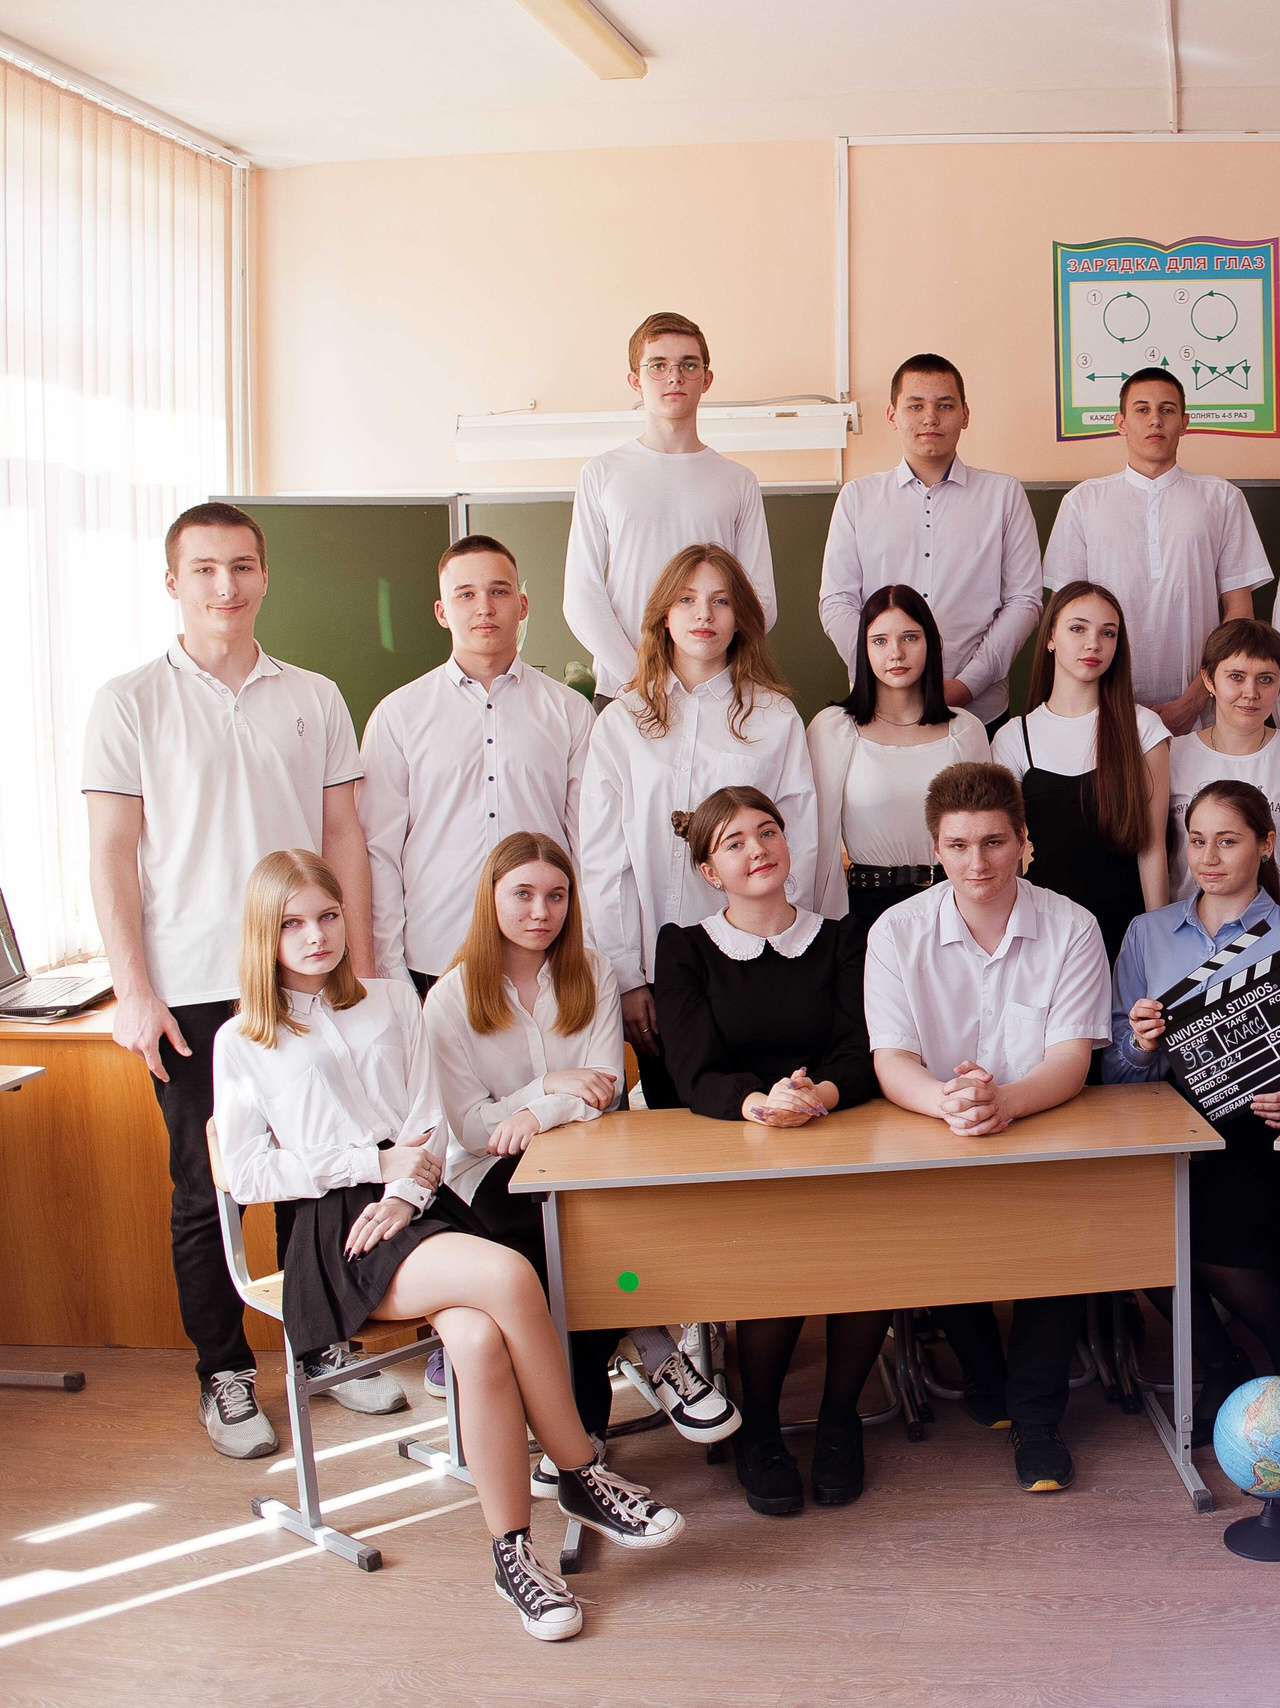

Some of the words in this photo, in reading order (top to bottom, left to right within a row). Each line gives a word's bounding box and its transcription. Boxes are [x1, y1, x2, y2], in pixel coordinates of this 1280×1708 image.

[1067, 257, 1160, 274] ЗАРЯДКА
[1165, 256, 1208, 273] ДЛЯ
[1214, 256, 1266, 270] ГЛАЗ
[1166, 1010, 1226, 1046] UNIVERSAL
[1225, 1013, 1248, 1029] TAKE
[1180, 1034, 1209, 1054] SCENE
[1188, 1071, 1208, 1085] DATE
[1194, 1074, 1230, 1096] PROD.CO.
[1202, 1085, 1240, 1108] DIRECTOR
[1210, 1093, 1255, 1121] CAMERAMAN
